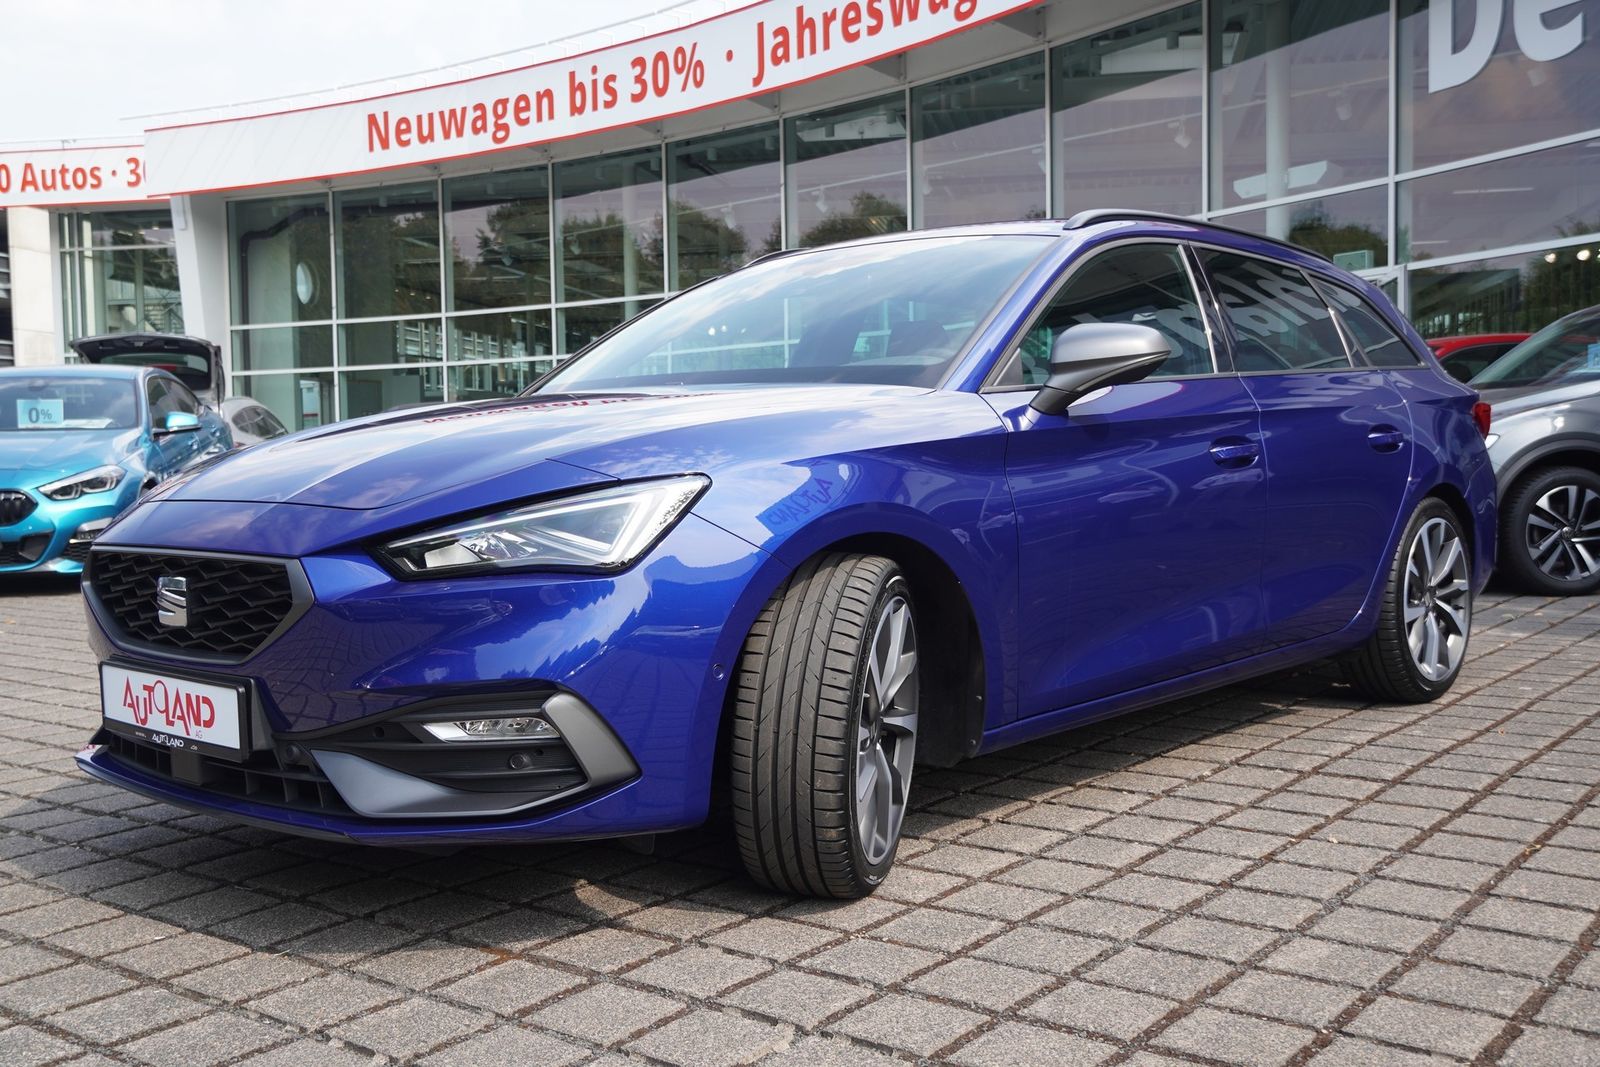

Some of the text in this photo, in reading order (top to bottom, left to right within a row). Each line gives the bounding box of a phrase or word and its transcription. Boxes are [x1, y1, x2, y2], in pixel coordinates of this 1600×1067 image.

[367, 87, 555, 153] Neuwagen
[569, 65, 618, 117] bis
[630, 42, 705, 104] 30%
[20, 162, 103, 192] Autos
[126, 156, 147, 188] 3
[123, 676, 215, 736] AUTOLAND
